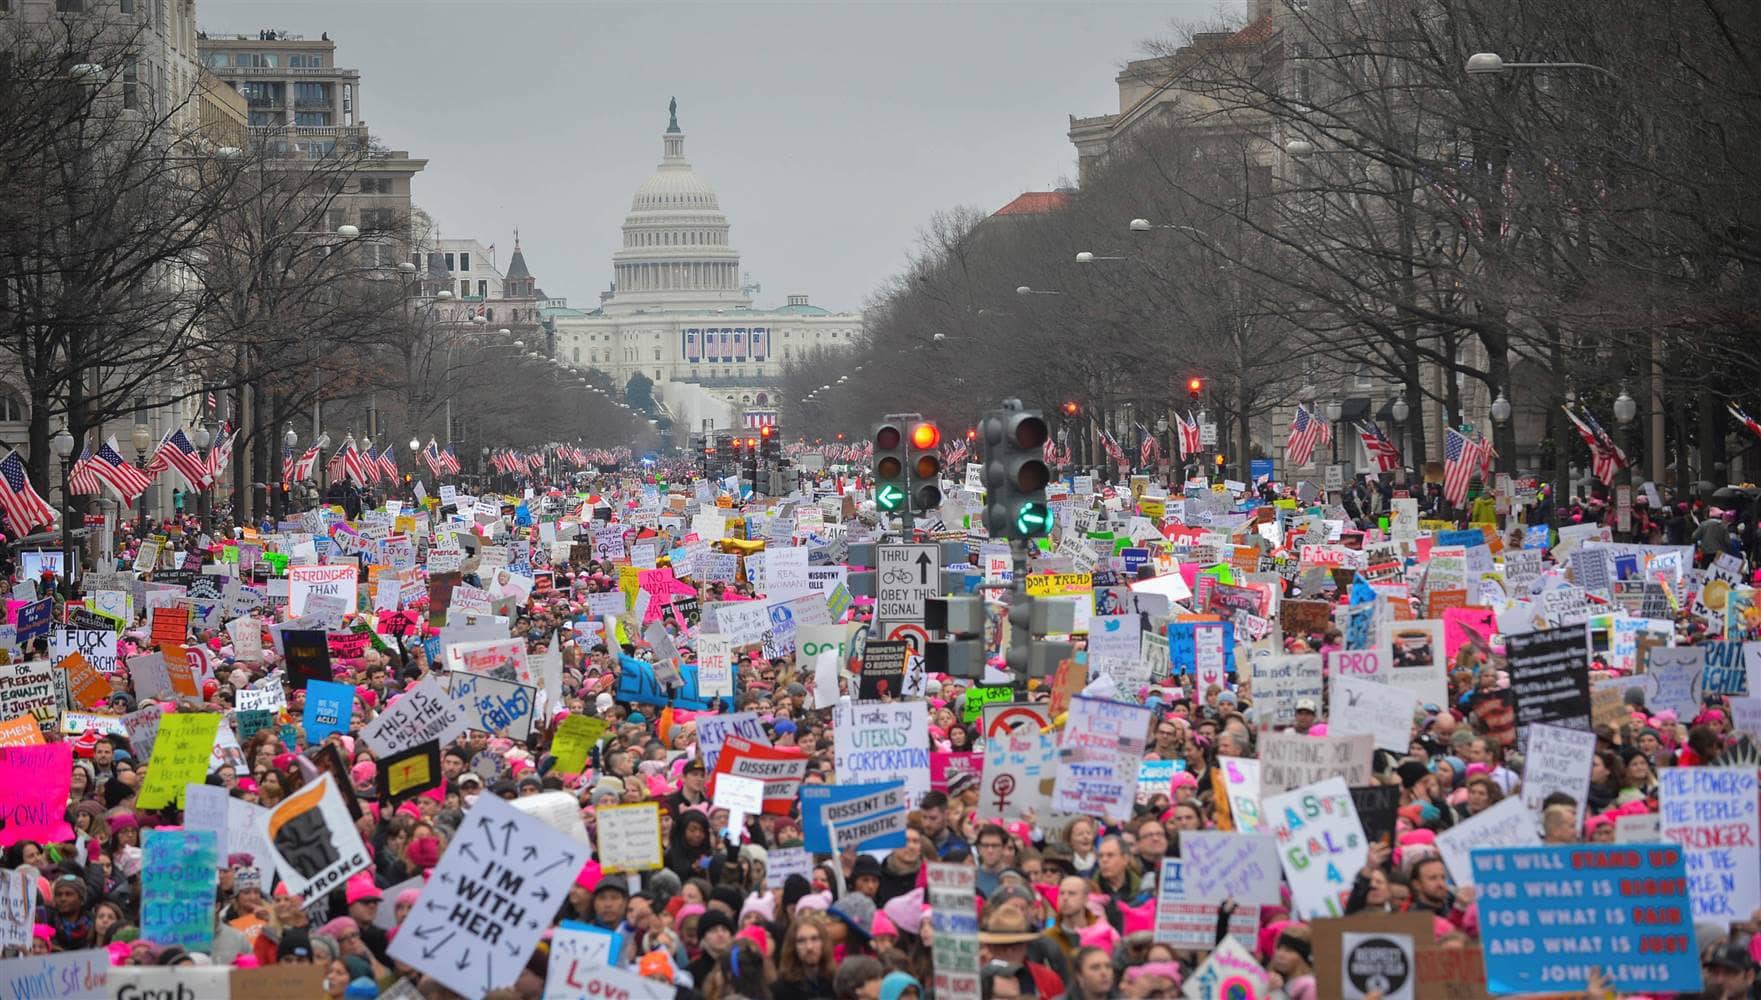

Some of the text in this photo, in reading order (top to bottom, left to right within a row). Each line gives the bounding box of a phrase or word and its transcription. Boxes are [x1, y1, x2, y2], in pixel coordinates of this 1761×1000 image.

[880, 550, 909, 562] THRU
[1650, 557, 1676, 570] FUCK
[292, 569, 354, 582] STRONGER
[647, 571, 664, 583] NO
[1504, 561, 1541, 579] GREATER
[808, 581, 824, 590] KILLS
[1053, 574, 1091, 586] TREAD
[308, 584, 339, 596] THAN
[880, 588, 937, 600] OBEY THIS
[880, 603, 919, 616] SIGNAL
[66, 630, 108, 648] FUCK
[78, 647, 94, 655] THE
[15, 664, 32, 676] FOR
[701, 656, 725, 669] HATE
[1270, 664, 1291, 679] not
[1339, 652, 1379, 675] PRO
[0, 671, 52, 689] FREEDOM
[450, 676, 477, 700] NOT
[0, 685, 49, 701] EQUALITY
[10, 695, 56, 713] JUSTICE
[315, 714, 339, 725] ACLU
[373, 691, 429, 741] THIS IS
[388, 717, 418, 750] ONLY
[414, 698, 444, 727] THE
[850, 709, 856, 727] I
[860, 707, 889, 724] make
[894, 710, 913, 731] my
[0, 723, 34, 738] OMEN
[732, 718, 762, 739] NOT
[0, 734, 36, 747] ON'T
[851, 728, 908, 749] UTERUS
[739, 760, 800, 776] DISSENT IS
[847, 748, 930, 771] CORPORATION
[1660, 767, 1740, 796] THE POWER
[827, 791, 898, 820] DISSENT IS
[1664, 799, 1744, 823] THE PEOPLE
[837, 816, 898, 843] PATRIOTIC
[1664, 823, 1756, 850] STRONGER
[1287, 830, 1359, 871] GALS
[1475, 850, 1679, 870] WE WILL STAND UP
[303, 853, 365, 897] WRONG
[481, 860, 524, 897] I'M
[1476, 879, 1688, 899] FOR WHAT IS RIGHT
[455, 873, 527, 929] WITH
[143, 902, 213, 926] LIGHT
[1487, 907, 1682, 927] FOR WHAT IS FAIR
[448, 902, 505, 947] HER
[1489, 935, 1688, 955] AND WHAT IS JUST
[62, 961, 82, 997] sit
[1540, 966, 1596, 982] JOHN
[1610, 964, 1670, 982] LEWIS
[117, 982, 196, 1000] Grab
